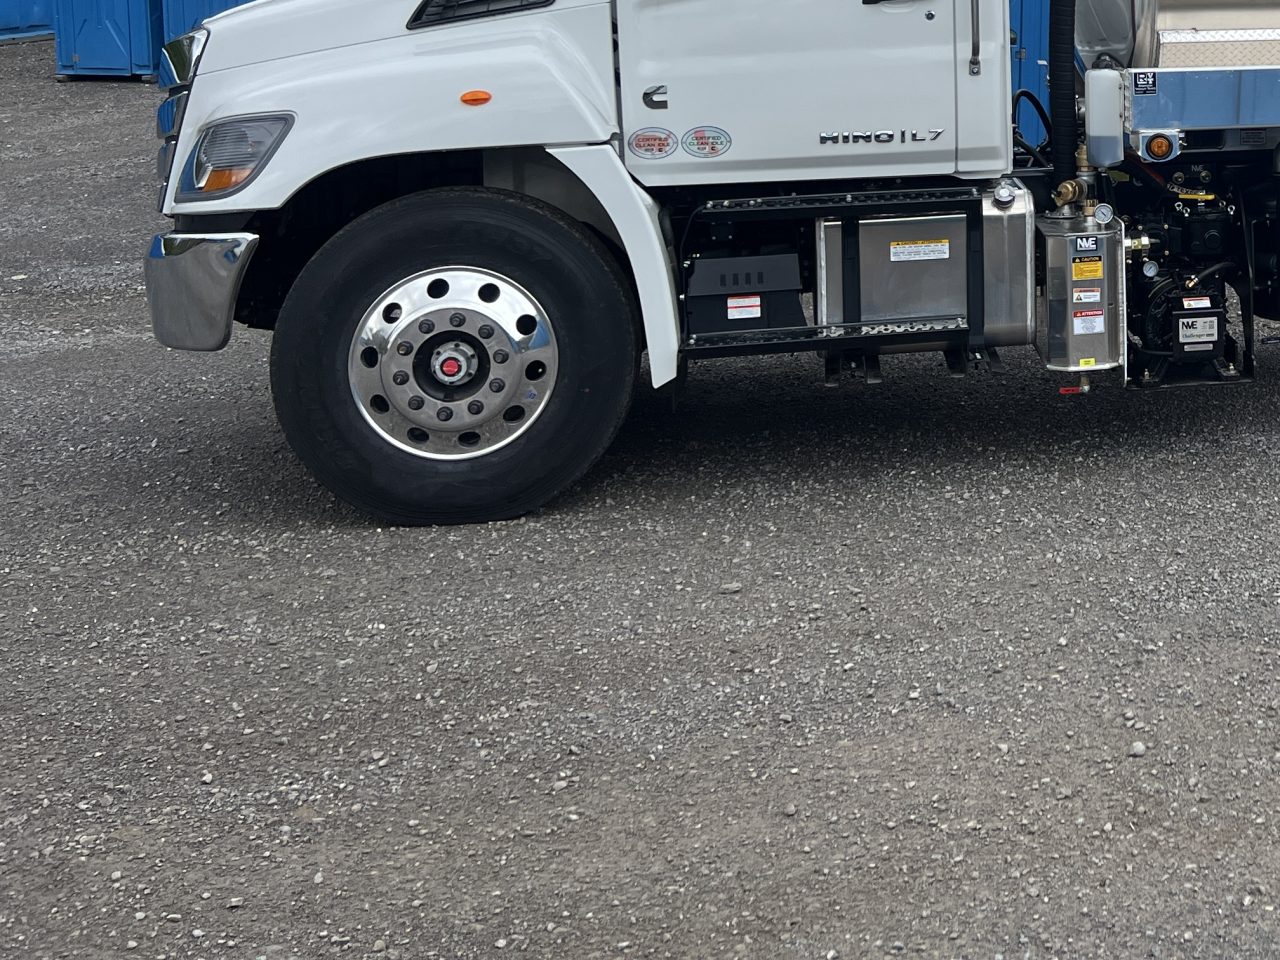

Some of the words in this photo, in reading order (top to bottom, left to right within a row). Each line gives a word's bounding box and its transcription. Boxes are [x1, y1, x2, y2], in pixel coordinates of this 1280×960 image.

[819, 130, 895, 144] HINO
[911, 128, 945, 142] L7
[1076, 237, 1097, 248] NVE
[1181, 320, 1198, 330] NVE
